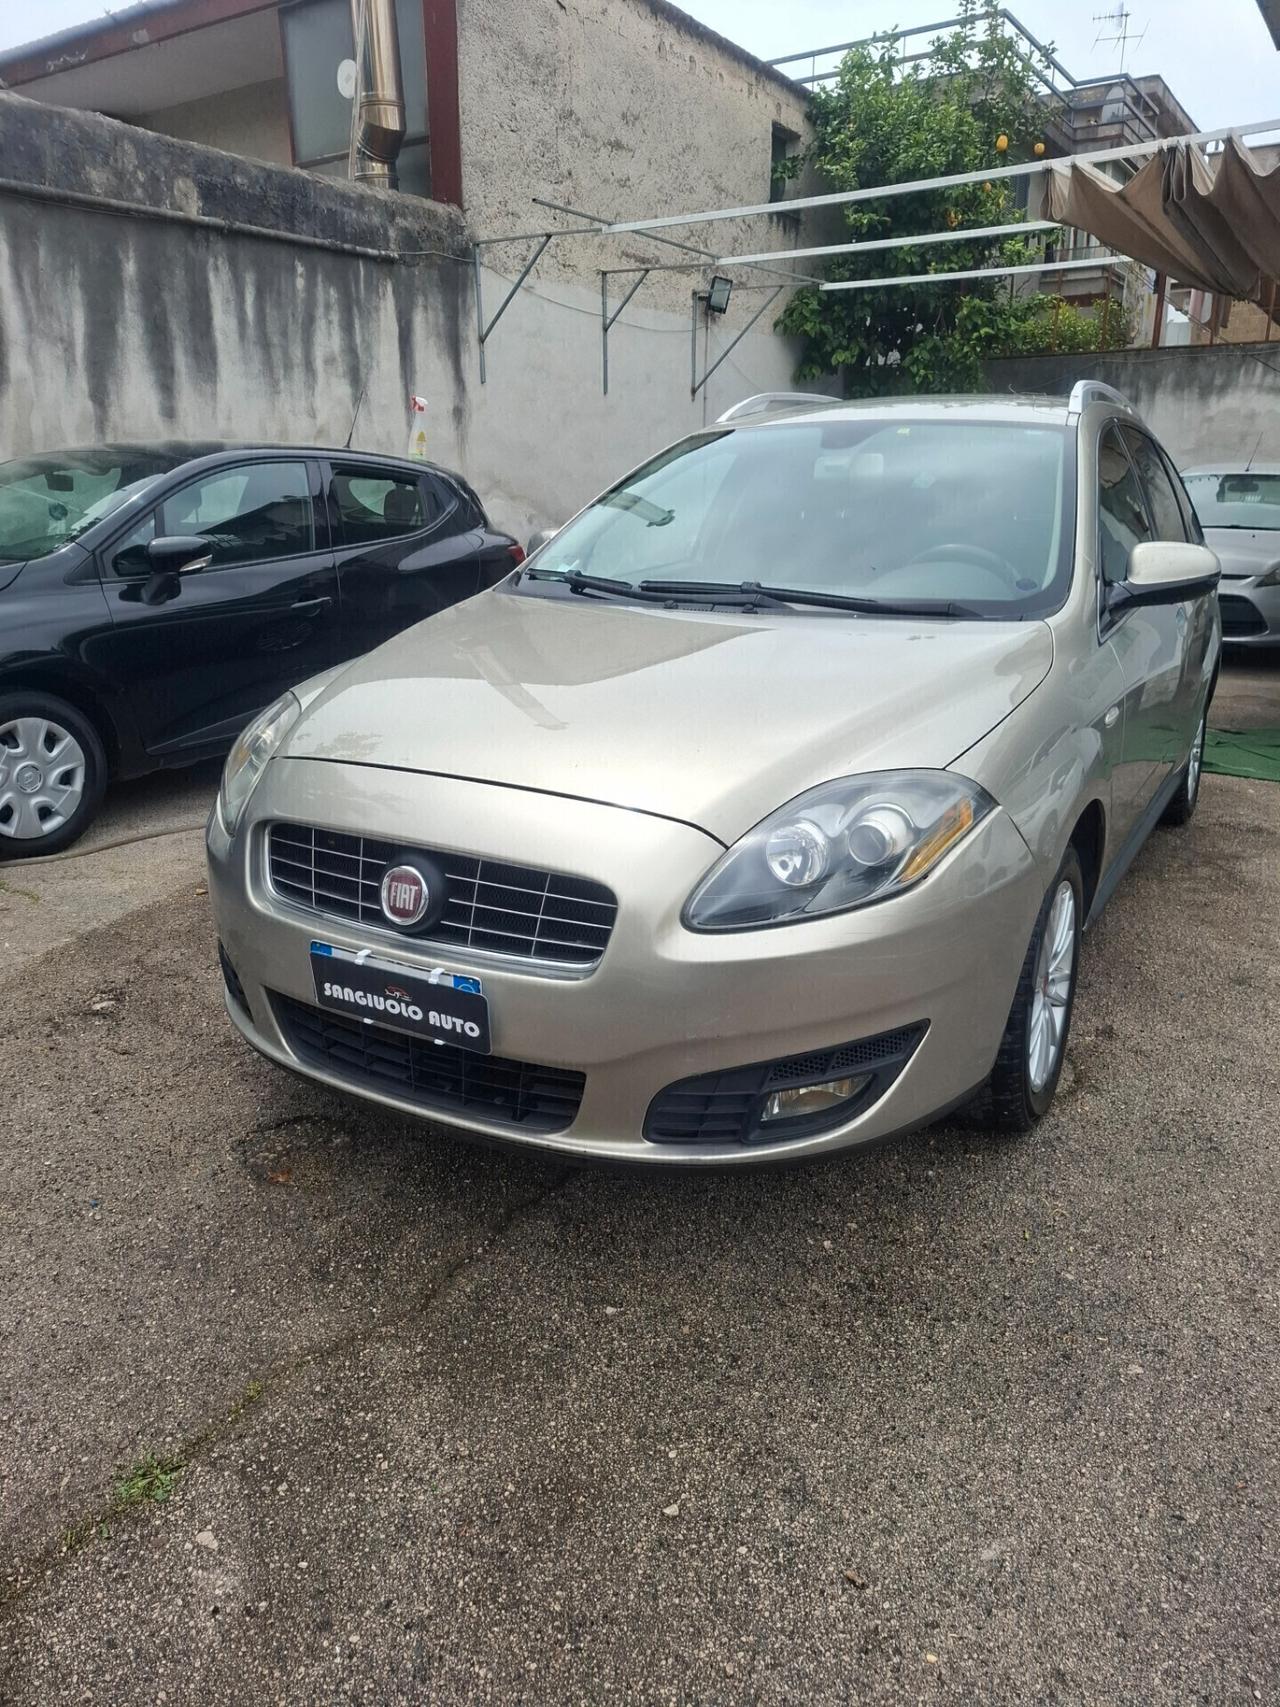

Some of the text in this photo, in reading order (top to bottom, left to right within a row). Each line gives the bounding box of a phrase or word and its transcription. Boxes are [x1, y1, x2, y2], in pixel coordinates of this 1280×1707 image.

[389, 881, 419, 911] FIAT
[323, 982, 481, 1038] SANGIUOLO AUTO
